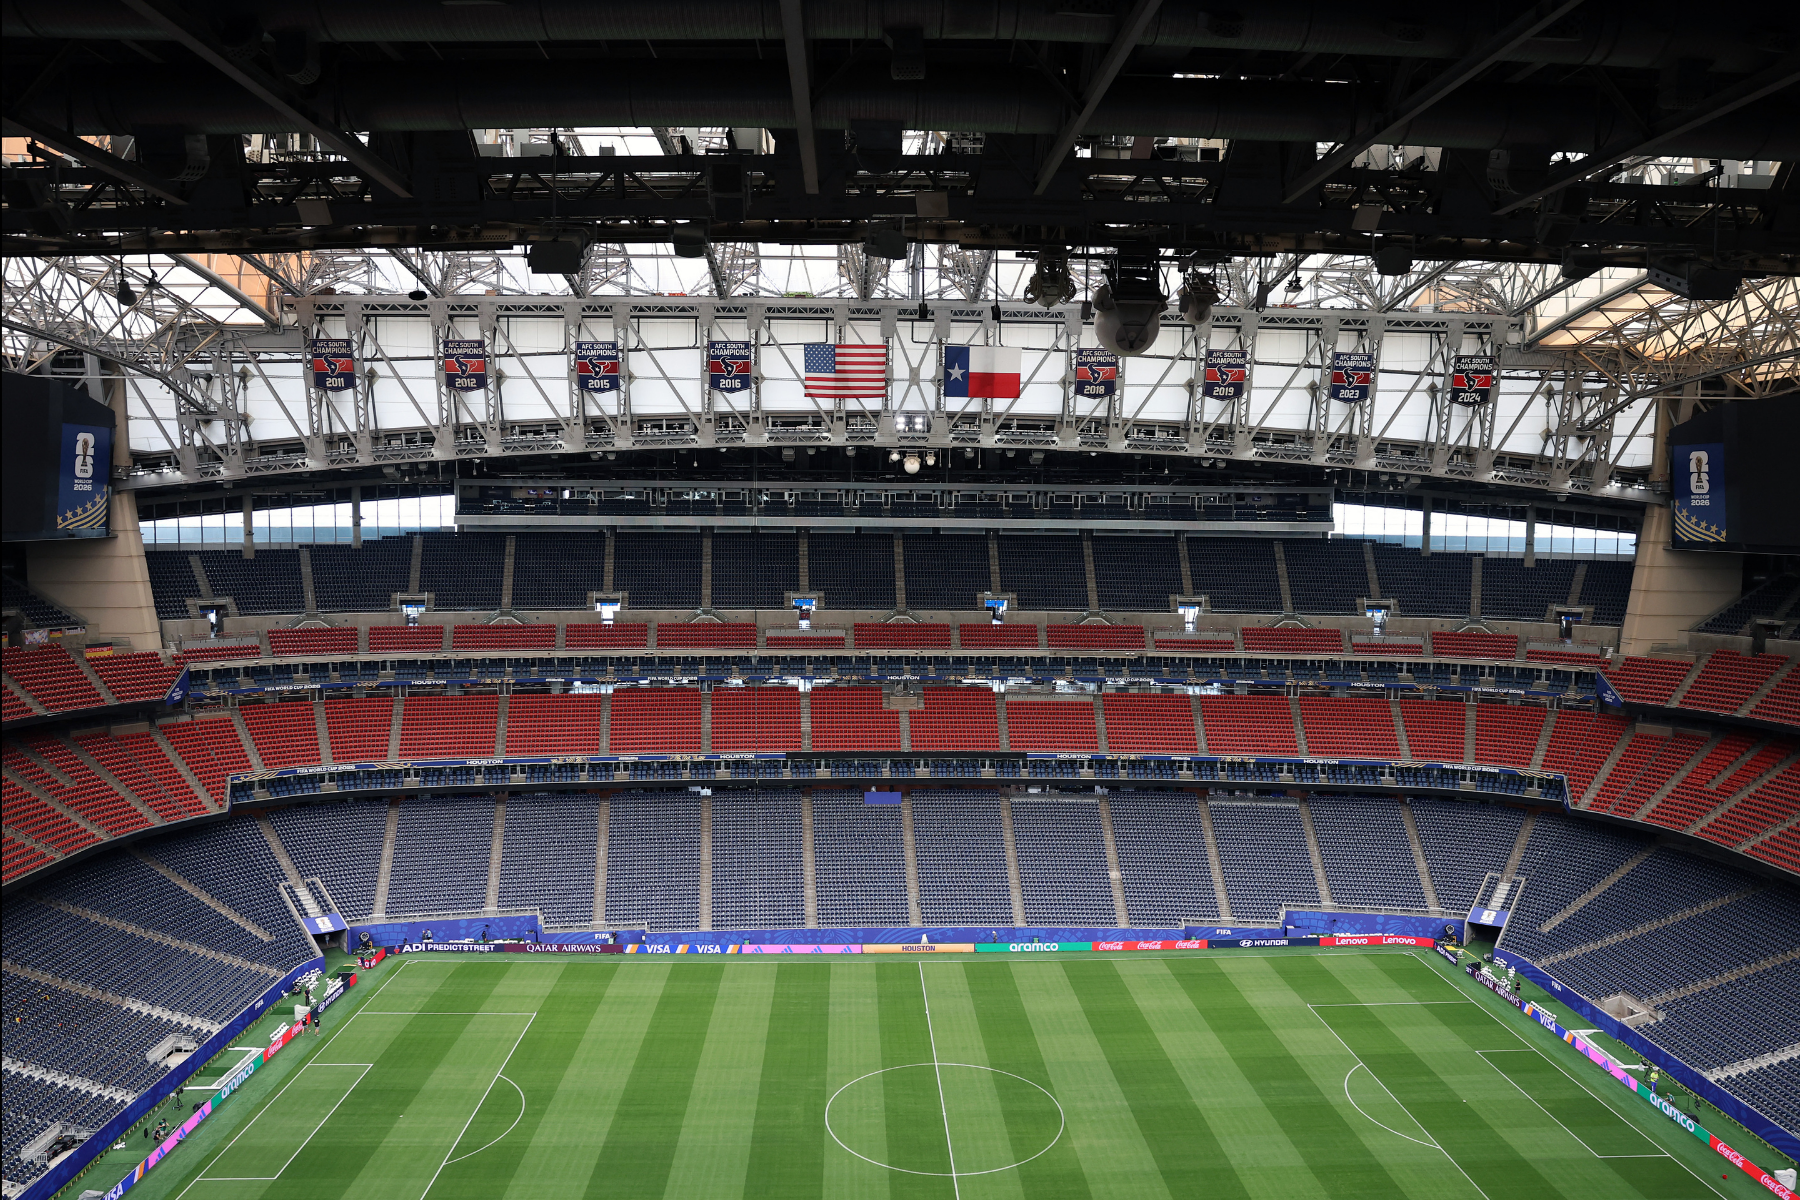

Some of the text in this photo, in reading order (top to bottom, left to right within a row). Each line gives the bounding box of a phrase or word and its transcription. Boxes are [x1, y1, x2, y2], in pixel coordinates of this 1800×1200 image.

[1456, 363, 1492, 371] CHAMPIONS
[326, 378, 345, 387] 2011
[455, 378, 477, 388] 2012
[588, 379, 610, 388] 2015
[720, 379, 741, 388] 2016
[1084, 385, 1105, 395] 2018
[1213, 386, 1234, 396] 2019
[1339, 390, 1359, 398] 2023
[1458, 393, 1481, 402] 2024
[1336, 936, 1368, 944] Lenovo
[1383, 936, 1416, 945] Lenovo
[403, 944, 426, 952] ADI
[526, 944, 601, 953] QATAR AIRWAYS
[644, 945, 670, 953] VISA
[695, 945, 721, 953] VISA
[1009, 943, 1059, 952] aramco
[1475, 972, 1519, 1007] QATAR AIRWAYS
[1551, 981, 1562, 992] FIFA
[326, 986, 344, 1007] HYUNDAI
[255, 999, 264, 1010] FIFA
[1539, 1014, 1556, 1033] VISA
[221, 1063, 254, 1099] aramco
[1650, 1093, 1695, 1132] aramco
